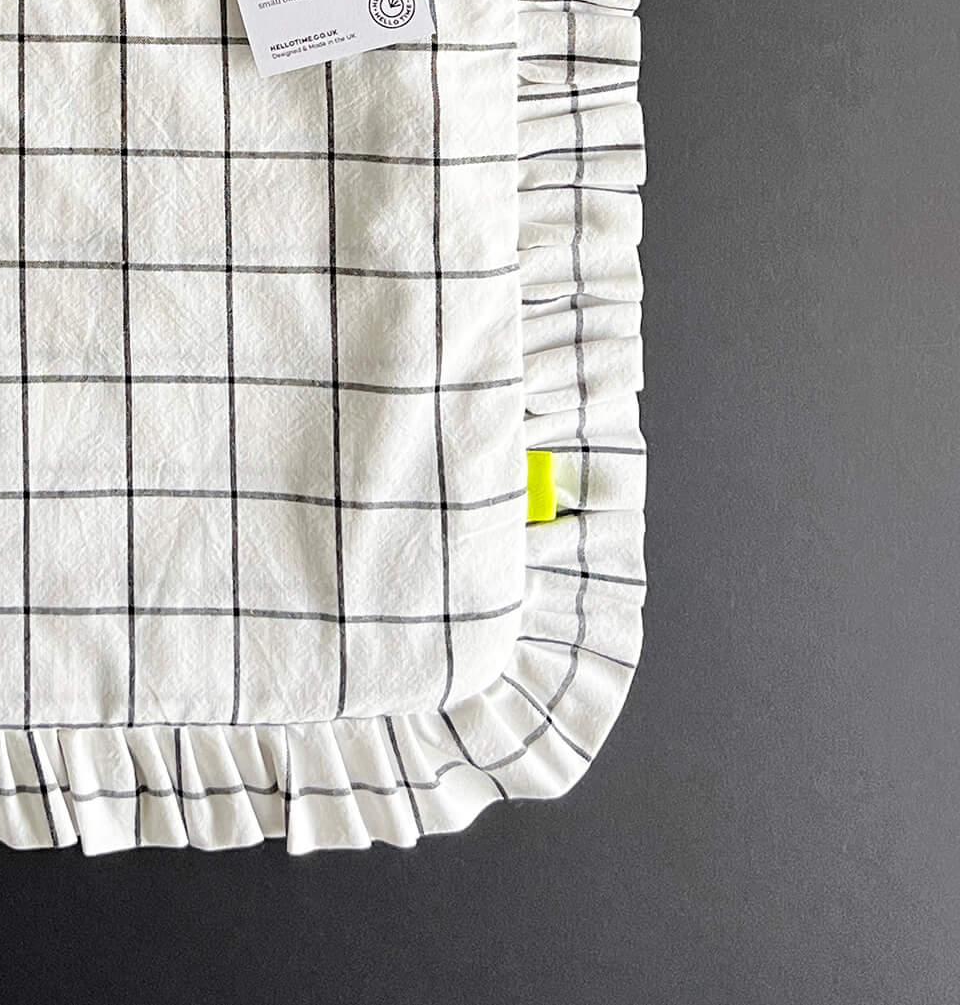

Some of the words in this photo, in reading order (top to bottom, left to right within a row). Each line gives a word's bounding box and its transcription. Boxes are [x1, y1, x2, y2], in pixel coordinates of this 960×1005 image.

[374, 11, 400, 26] HELLO
[399, 4, 413, 23] TIME
[272, 47, 302, 59] Designed
[308, 41, 326, 50] Made
[334, 35, 345, 44] the
